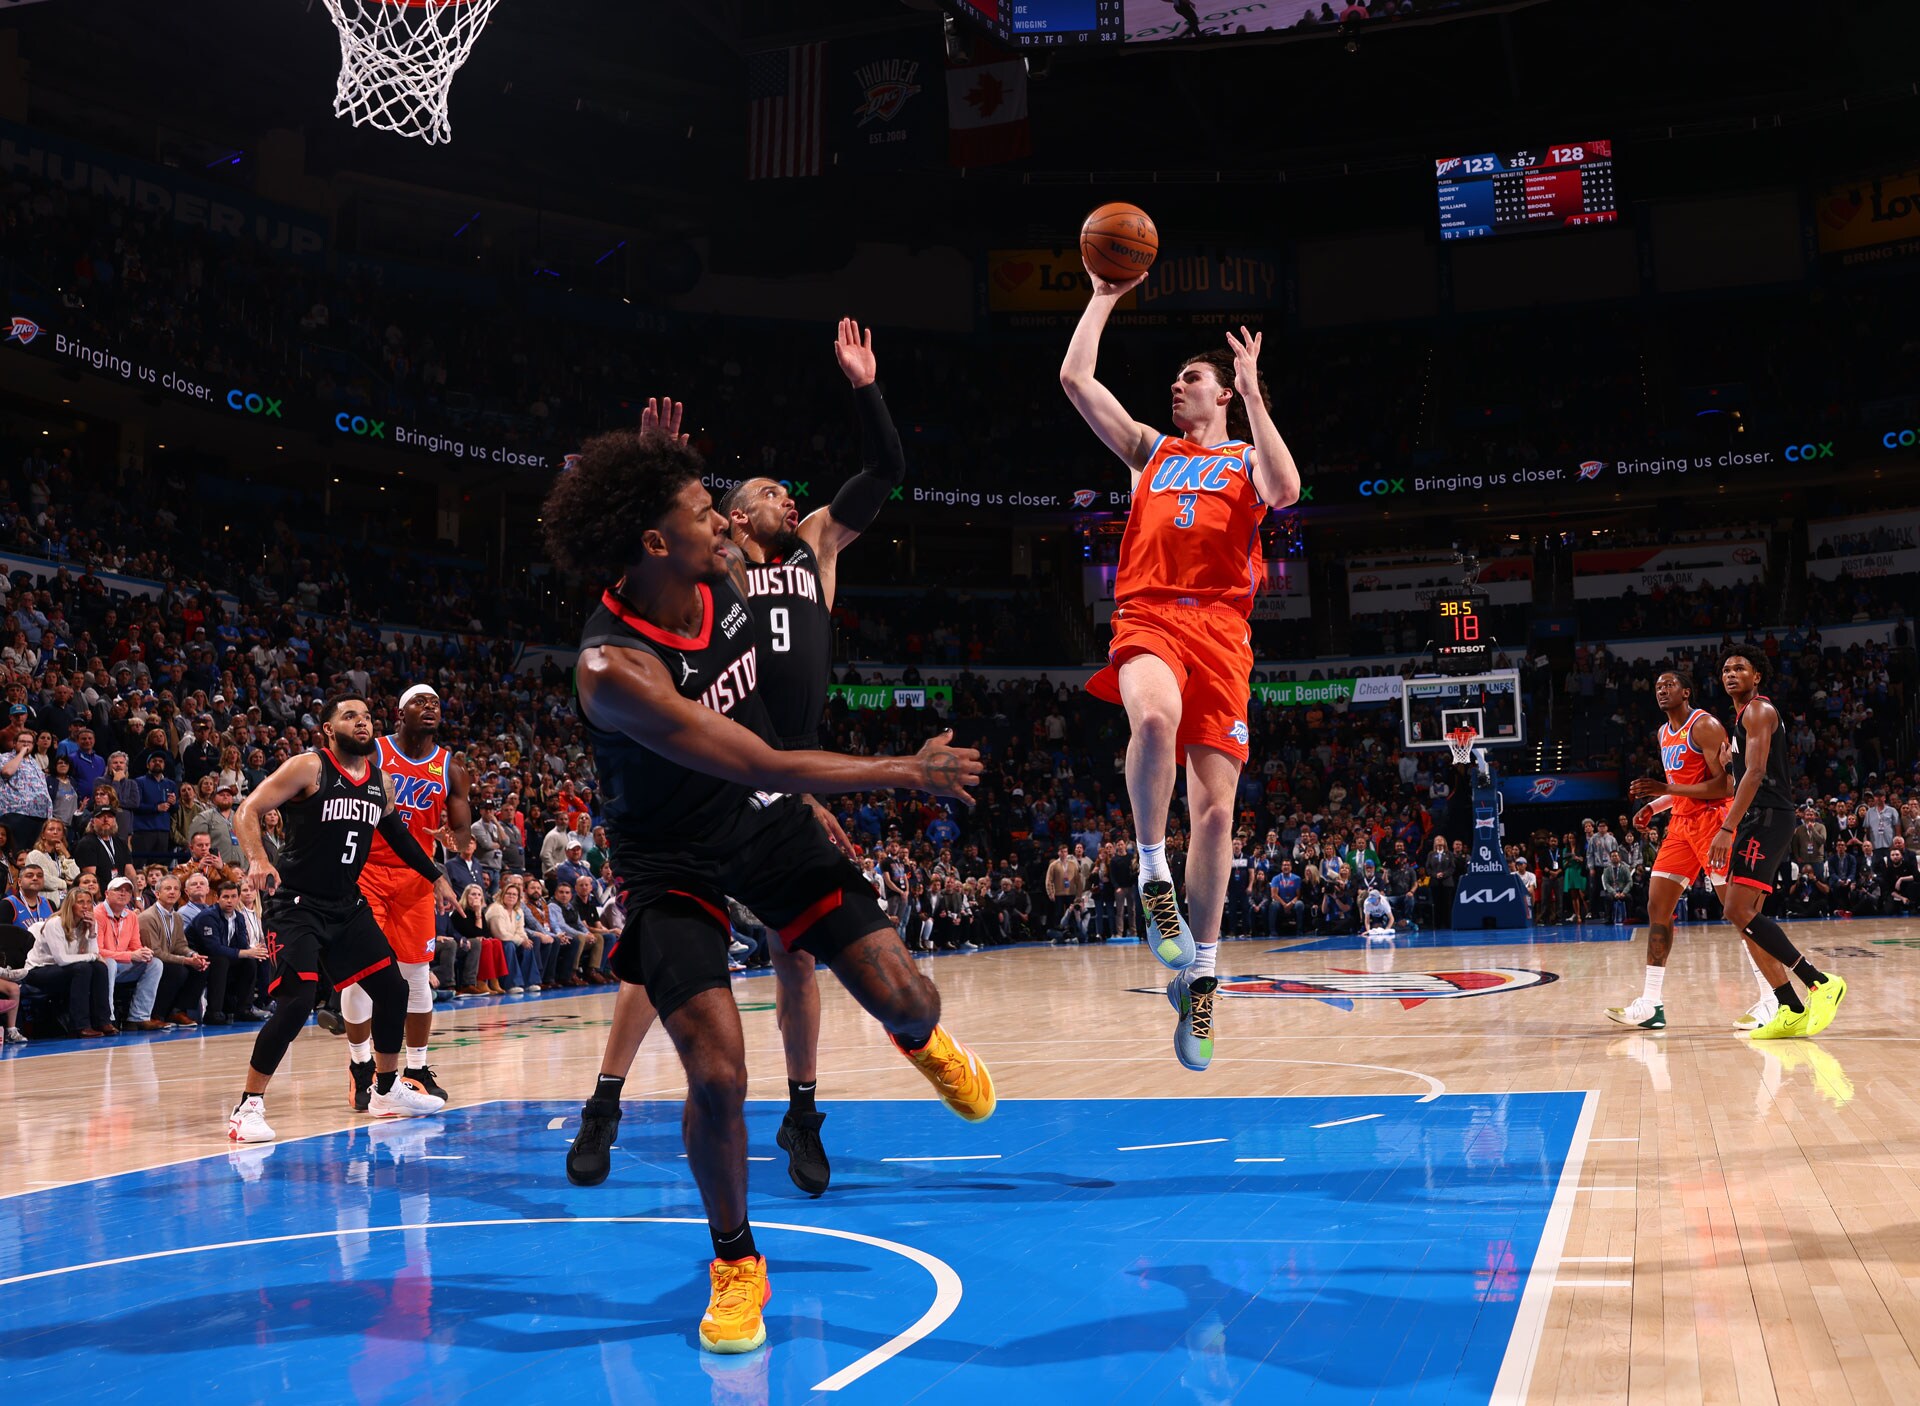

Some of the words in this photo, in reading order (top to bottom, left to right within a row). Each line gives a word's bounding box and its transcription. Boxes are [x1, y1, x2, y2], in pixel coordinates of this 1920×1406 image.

[1014, 5, 1027, 14] JOE
[1099, 2, 1109, 11] 17
[1114, 1, 1120, 10] 0
[1014, 20, 1047, 30] WIGGINS
[1099, 17, 1109, 26] 14
[1020, 36, 1030, 45] TO
[1034, 35, 1040, 44] 2
[1045, 35, 1054, 44] TF
[1078, 33, 1089, 42] OT
[853, 58, 920, 89] THUNDER
[1462, 157, 1495, 174] 123
[1551, 147, 1585, 164] 128
[1510, 156, 1536, 168] 38.7
[1440, 202, 1467, 211] WILLIAMS
[1220, 256, 1277, 300] CITY
[1191, 314, 1227, 325] EXIT
[1229, 312, 1264, 324] NOW
[55, 333, 132, 379] Bringing
[138, 363, 157, 383] us
[161, 371, 214, 402] closer.
[395, 426, 464, 457] Bringing
[469, 445, 487, 460] us
[491, 448, 549, 469] closer.
[1150, 455, 1244, 493] OKC
[1616, 456, 1688, 475] Bringing
[1693, 455, 1713, 469] us
[1718, 451, 1775, 467] closer.
[1414, 473, 1483, 494] Bringing
[1488, 472, 1507, 485] us
[1511, 466, 1567, 483] closer.
[913, 487, 981, 507] Bringing
[986, 492, 1003, 505] us
[1008, 491, 1060, 507] closer.
[1174, 493, 1198, 529] 3
[721, 602, 743, 628] credit
[1439, 601, 1472, 617] 38.5
[724, 611, 748, 640] karma
[769, 607, 791, 652] 9
[1454, 614, 1480, 641] 18
[1451, 645, 1486, 655] TISSOT
[1261, 685, 1292, 703] Your
[1295, 683, 1350, 701] Benefits
[1359, 681, 1390, 695] Check
[321, 797, 383, 829] HOUSTON
[341, 830, 359, 865] 5
[1471, 860, 1503, 873] Health
